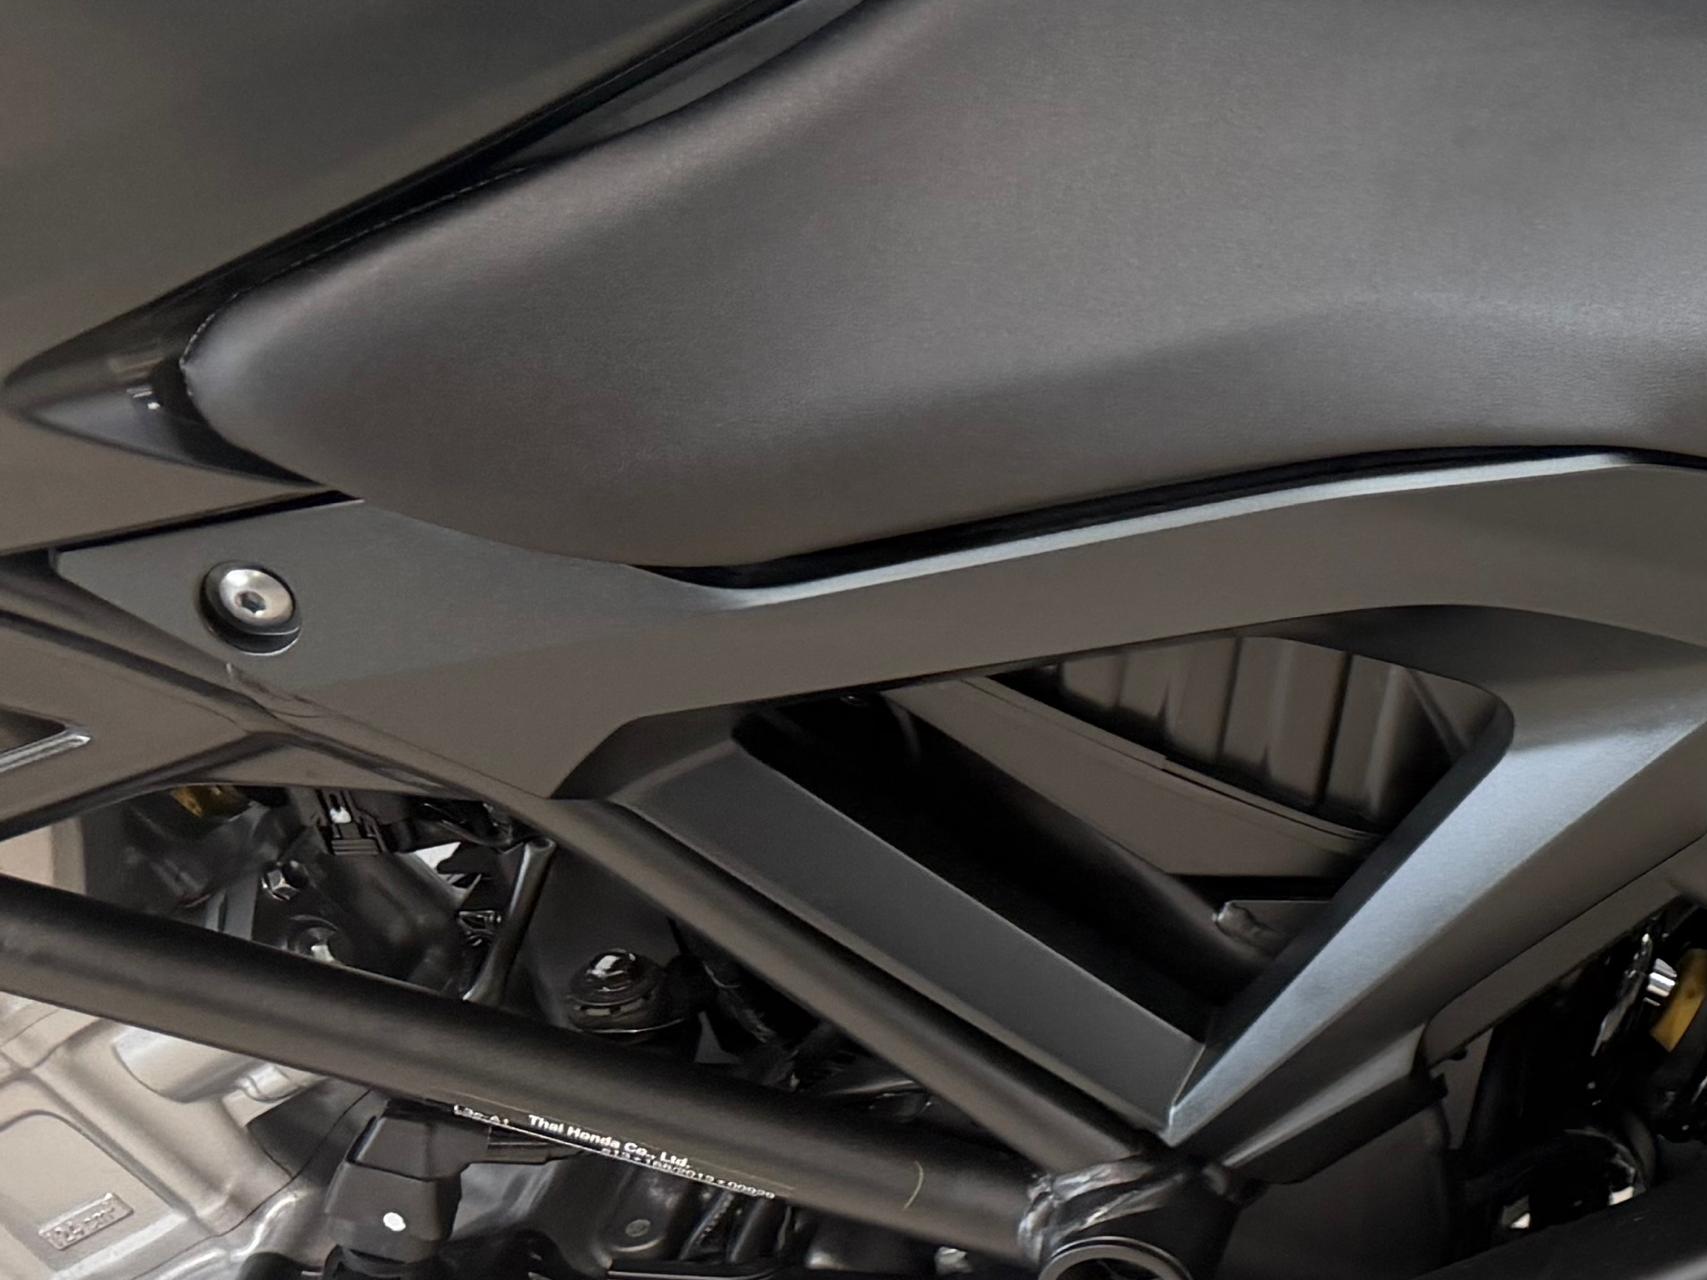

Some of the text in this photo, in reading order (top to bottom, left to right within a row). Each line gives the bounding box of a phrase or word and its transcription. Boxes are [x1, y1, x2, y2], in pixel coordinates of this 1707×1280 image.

[528, 1114, 690, 1169] Thai Honda Co., Ltd.
